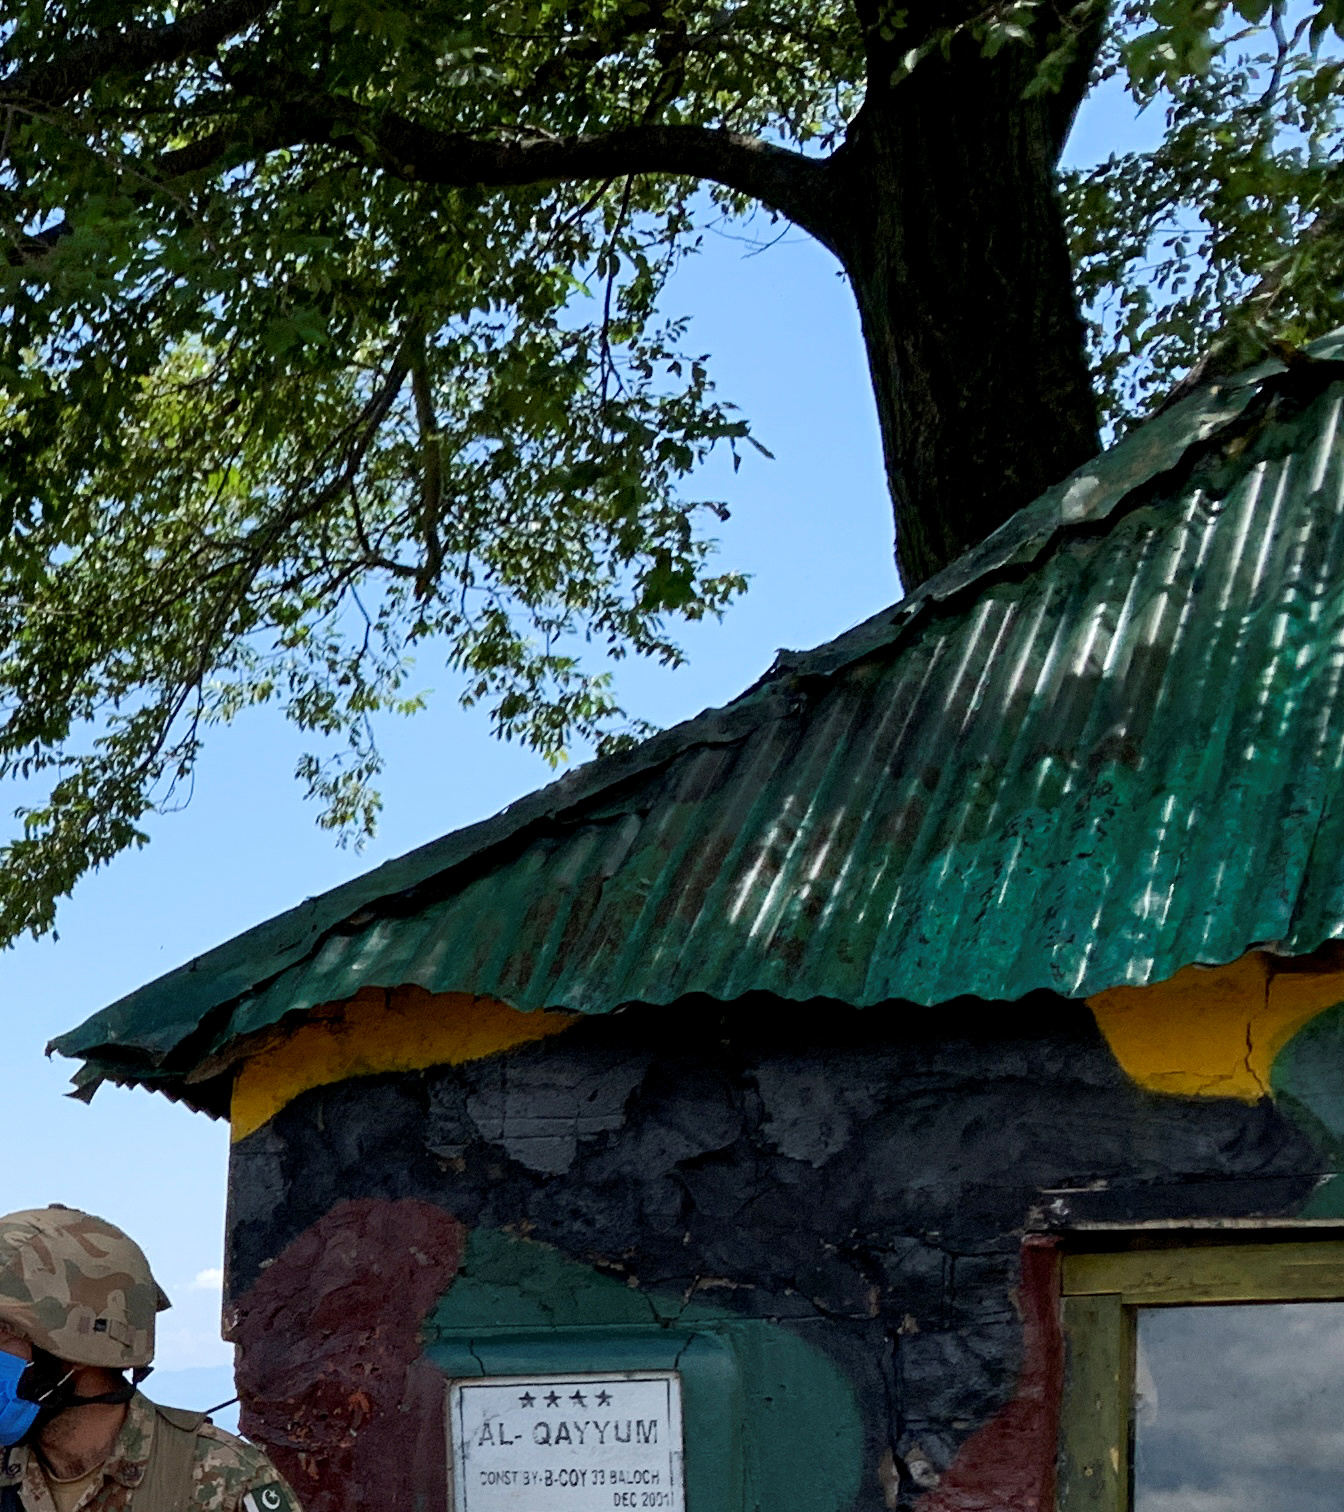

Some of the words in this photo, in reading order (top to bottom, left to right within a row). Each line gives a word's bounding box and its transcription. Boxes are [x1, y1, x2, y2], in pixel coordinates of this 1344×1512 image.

[478, 1421, 522, 1447] AL-
[532, 1419, 658, 1447] QAYYUM
[479, 1470, 518, 1486] CONST
[591, 1469, 605, 1485] 33
[610, 1469, 660, 1485] BALOCH
[613, 1491, 637, 1508] DEC
